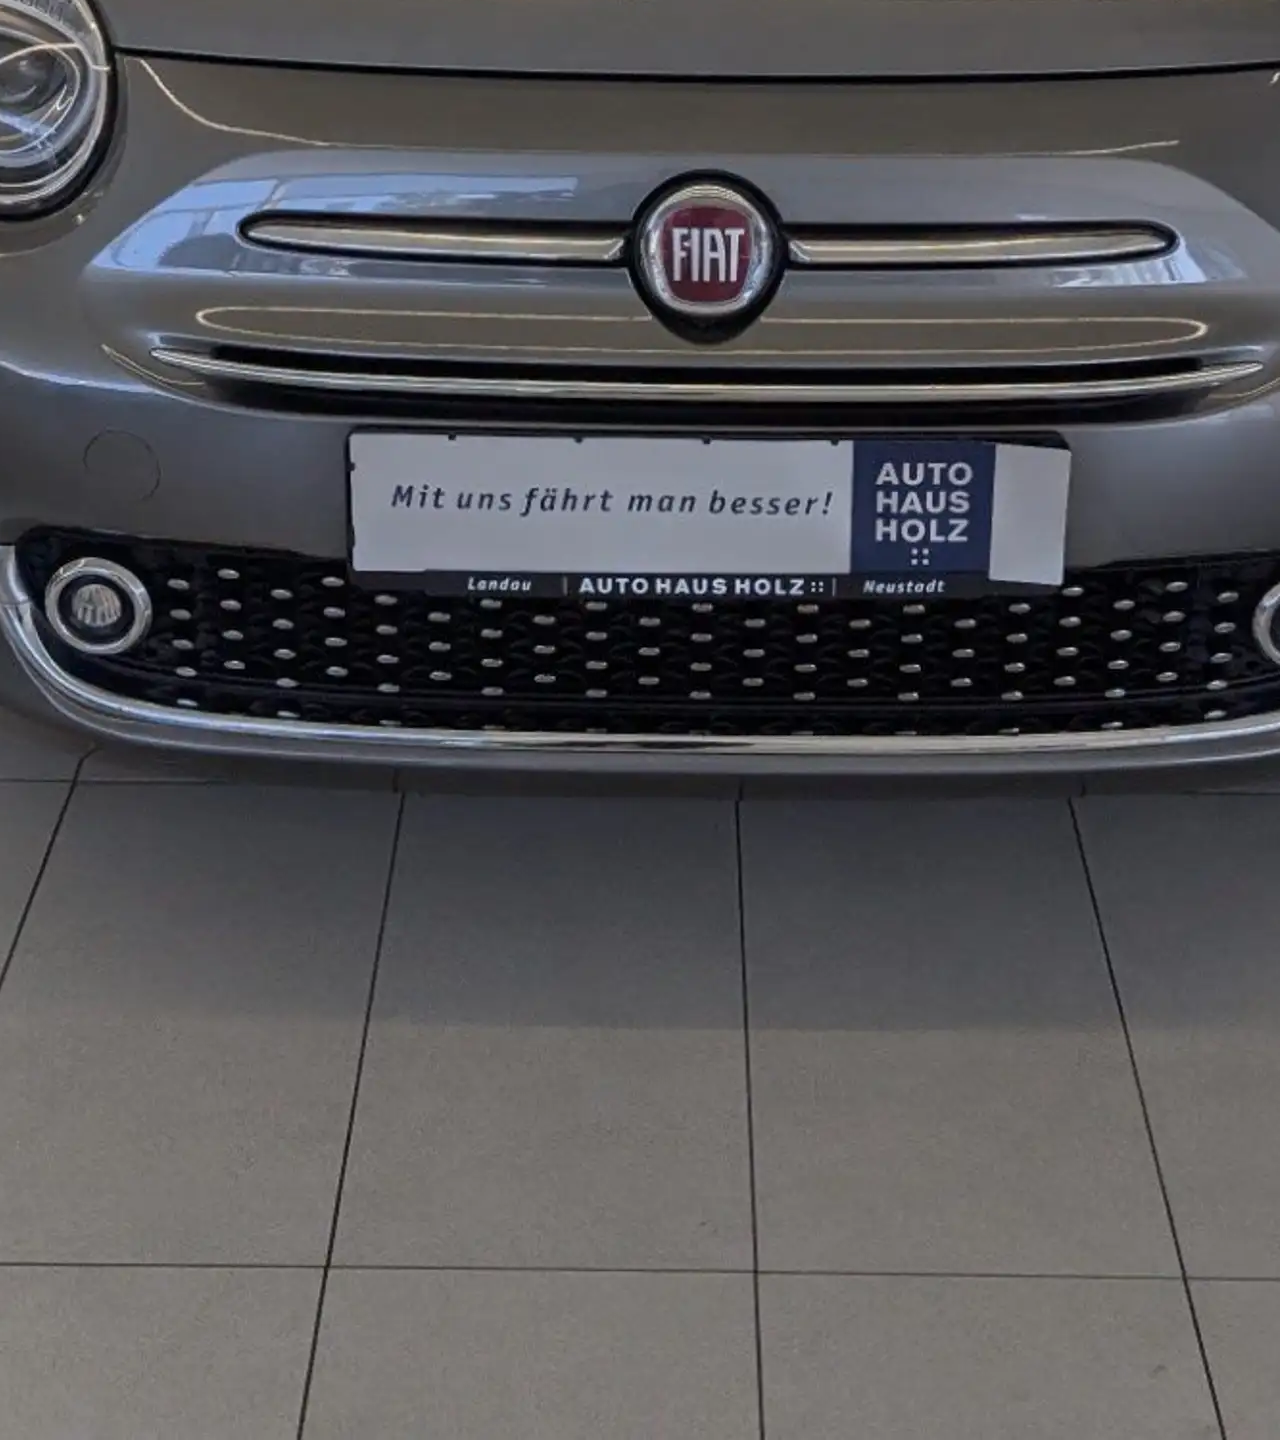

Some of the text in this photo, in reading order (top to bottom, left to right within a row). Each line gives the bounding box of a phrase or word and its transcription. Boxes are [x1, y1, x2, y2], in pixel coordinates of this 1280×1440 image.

[671, 227, 745, 282] FIAT
[875, 461, 973, 486] AUTO
[391, 484, 833, 518] Mit uns fährt man besser!
[875, 490, 970, 514] HAUS
[875, 518, 970, 543] HOLZ
[467, 575, 946, 596] Landau AUTO HAUS HOLZ Neustadt
